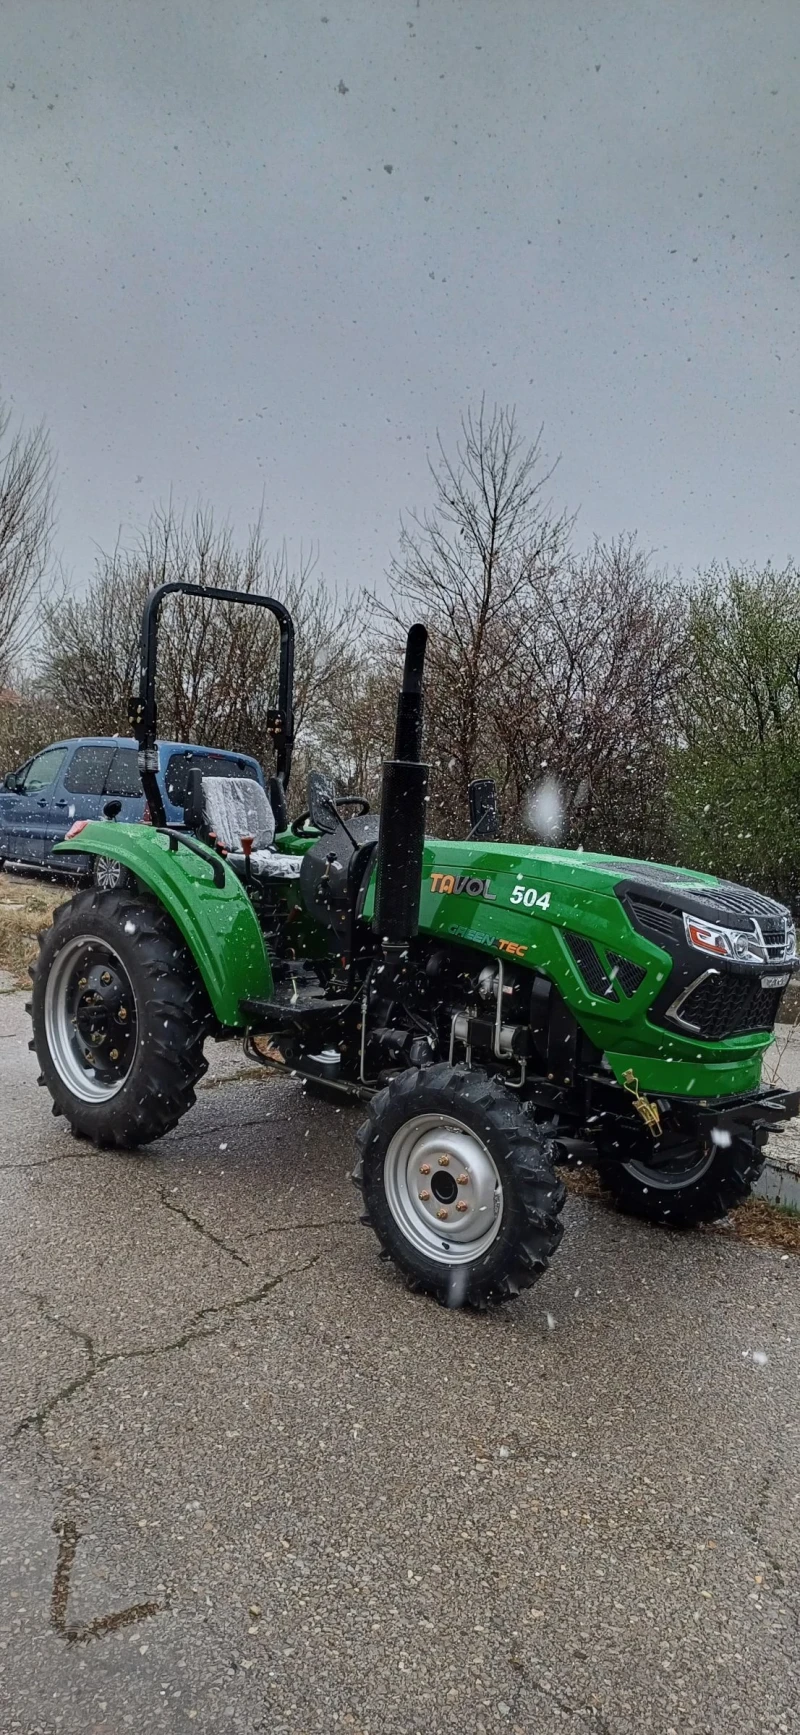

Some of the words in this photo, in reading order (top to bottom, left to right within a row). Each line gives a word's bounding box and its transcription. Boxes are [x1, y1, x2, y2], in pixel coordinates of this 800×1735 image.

[430, 873, 496, 900] TAVOL
[510, 885, 551, 910] 504
[448, 923, 496, 946] GREEN
[498, 939, 528, 957] TEC
